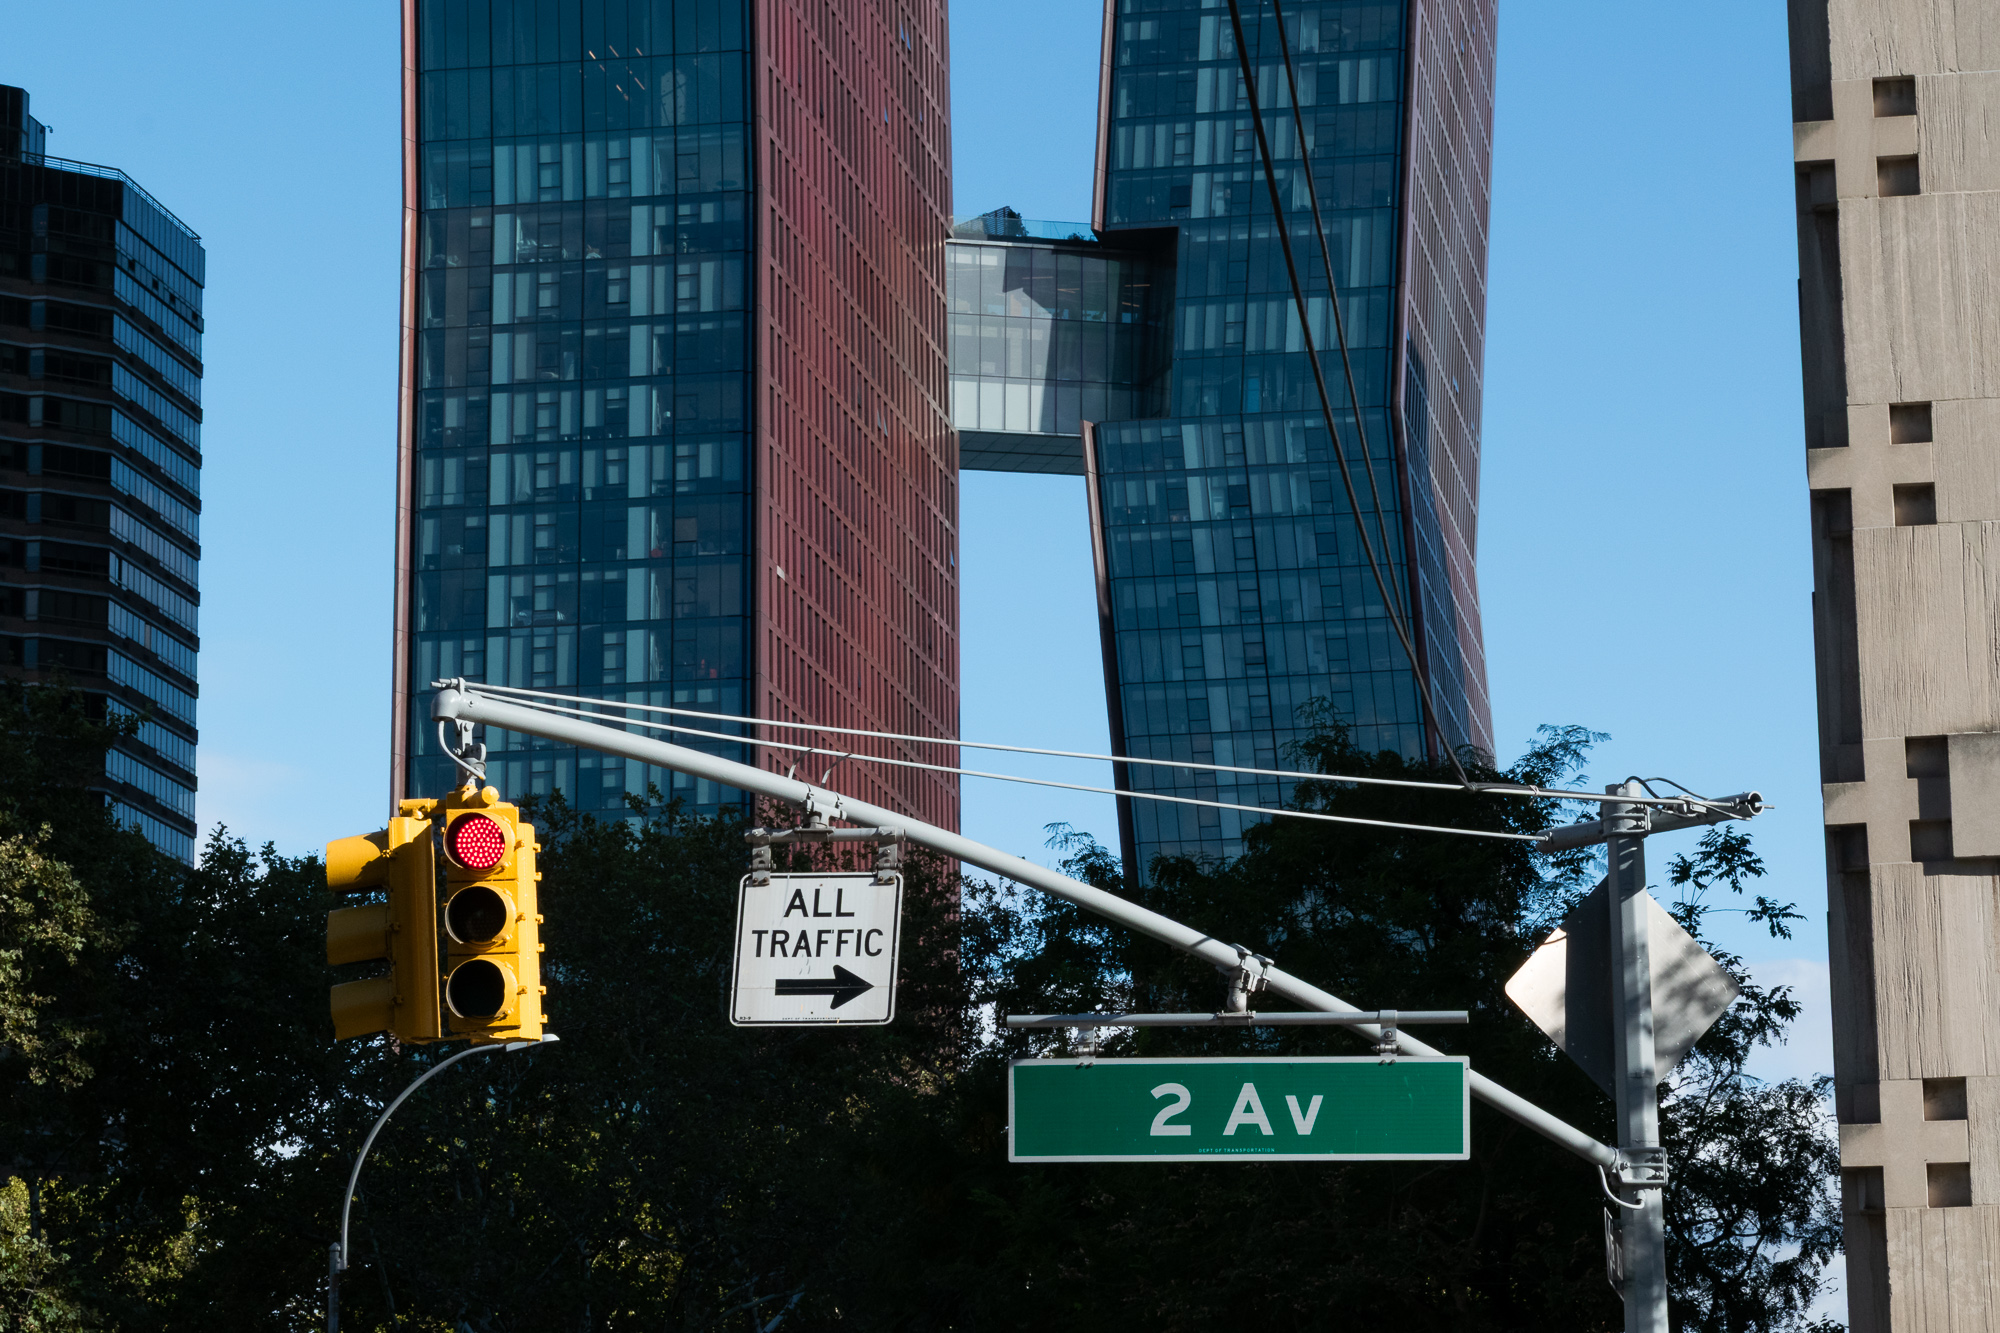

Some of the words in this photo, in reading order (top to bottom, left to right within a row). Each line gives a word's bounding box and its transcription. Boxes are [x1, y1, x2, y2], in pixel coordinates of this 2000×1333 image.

[783, 888, 855, 918] ALL
[751, 928, 884, 958] TRAFFIC
[1149, 1082, 1192, 1136] 2
[1222, 1082, 1324, 1136] Av
